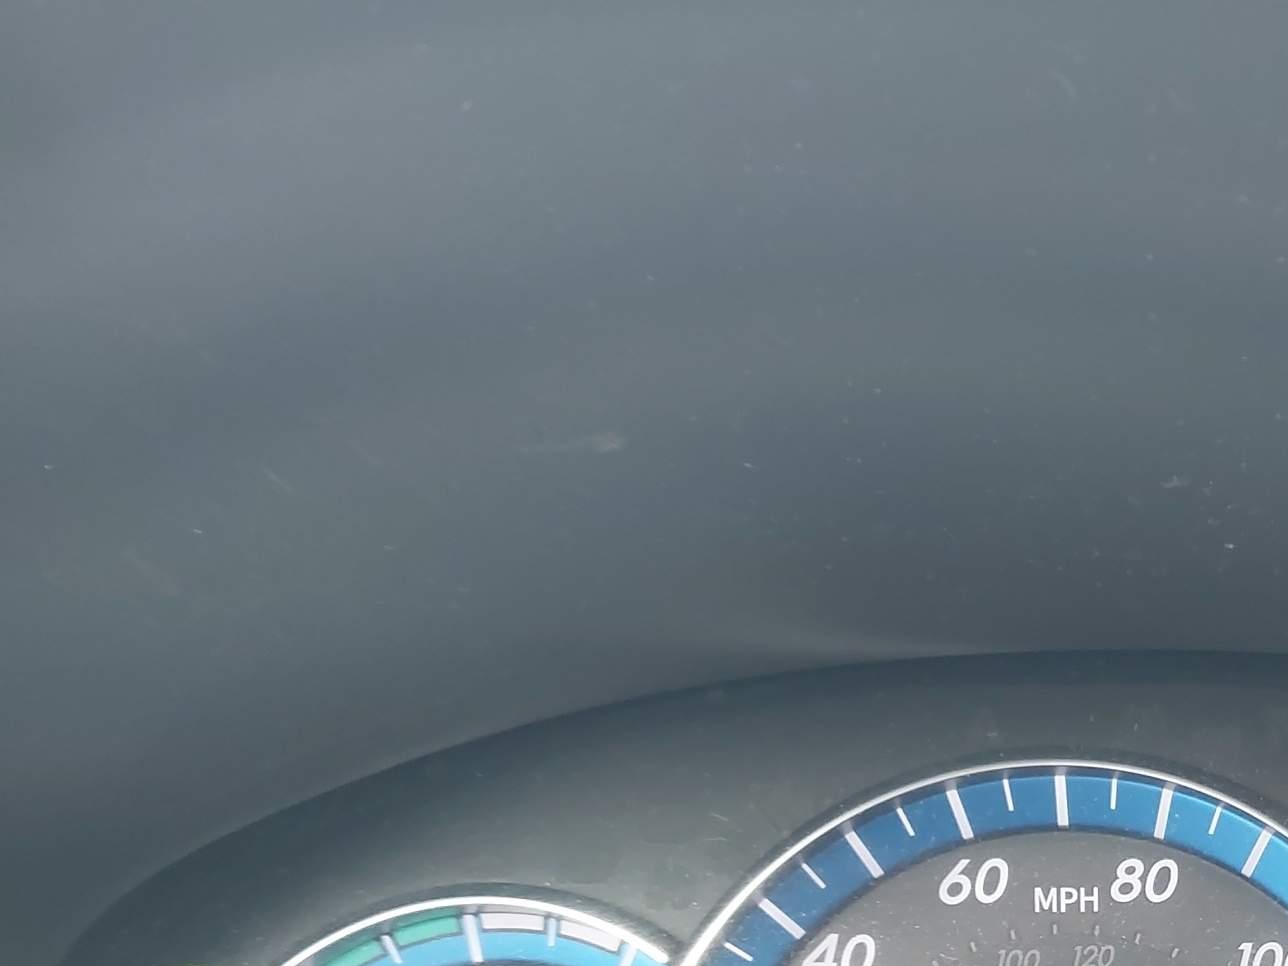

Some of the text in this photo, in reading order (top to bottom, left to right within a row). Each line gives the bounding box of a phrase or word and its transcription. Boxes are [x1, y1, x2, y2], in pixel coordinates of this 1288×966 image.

[939, 858, 1008, 904] 60
[1034, 887, 1099, 912] MPH
[1111, 859, 1178, 902] 80
